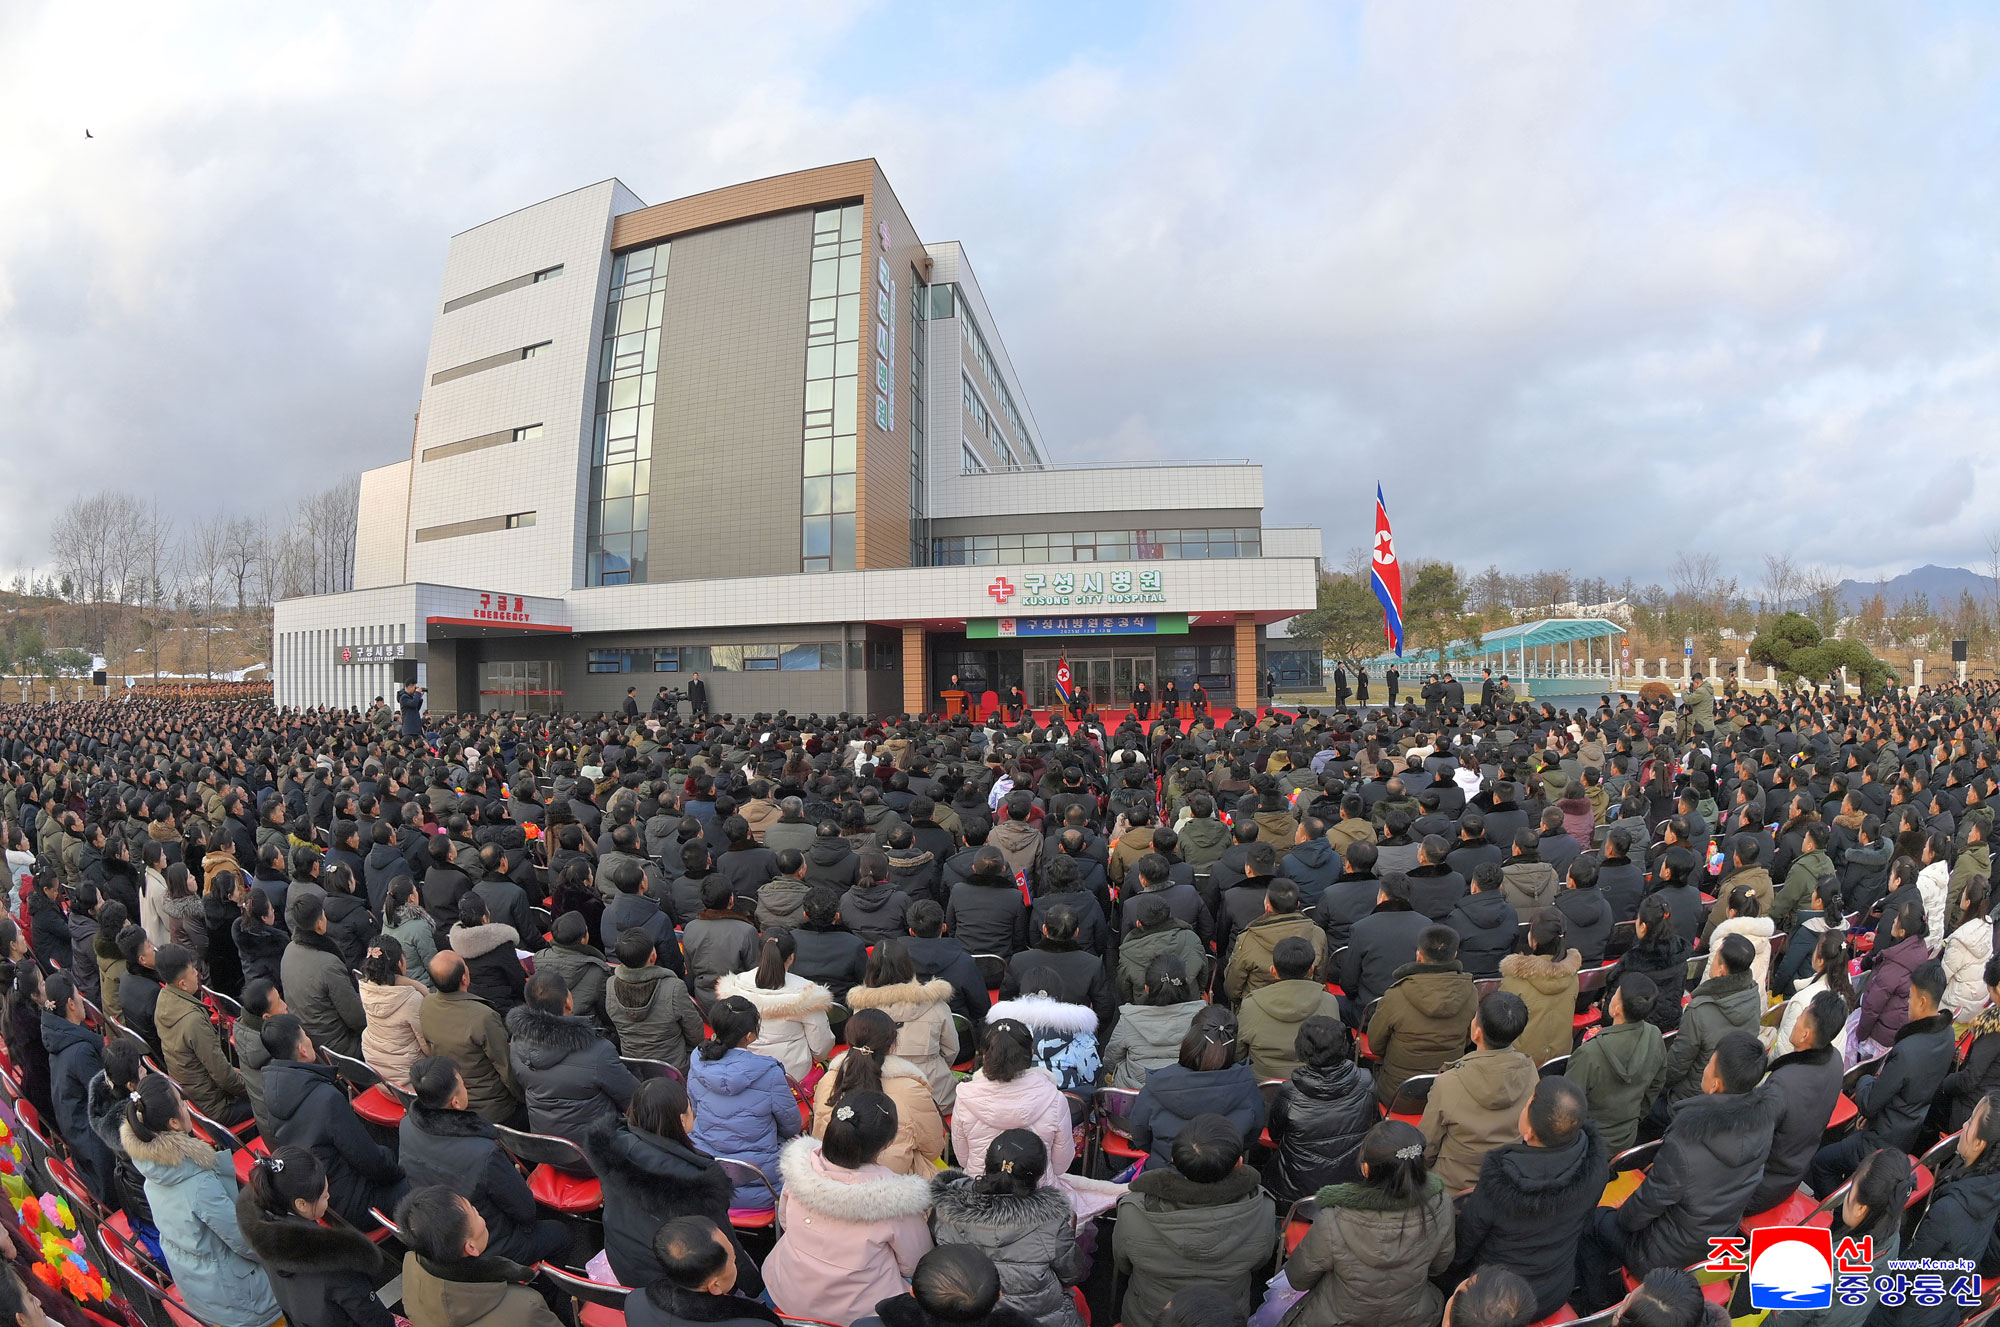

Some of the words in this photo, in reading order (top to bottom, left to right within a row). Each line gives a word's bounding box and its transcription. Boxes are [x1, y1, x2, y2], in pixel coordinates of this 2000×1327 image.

[877, 257, 889, 430] 구성시병원
[1024, 570, 1162, 594] 구성시병원
[480, 593, 523, 612] 구급과
[1022, 596, 1070, 606] KUSONG
[1075, 595, 1103, 605] CITY
[1107, 593, 1166, 604] HOSPITAL
[474, 609, 530, 622] EMERGENCY
[357, 645, 404, 657] 구성시병원
